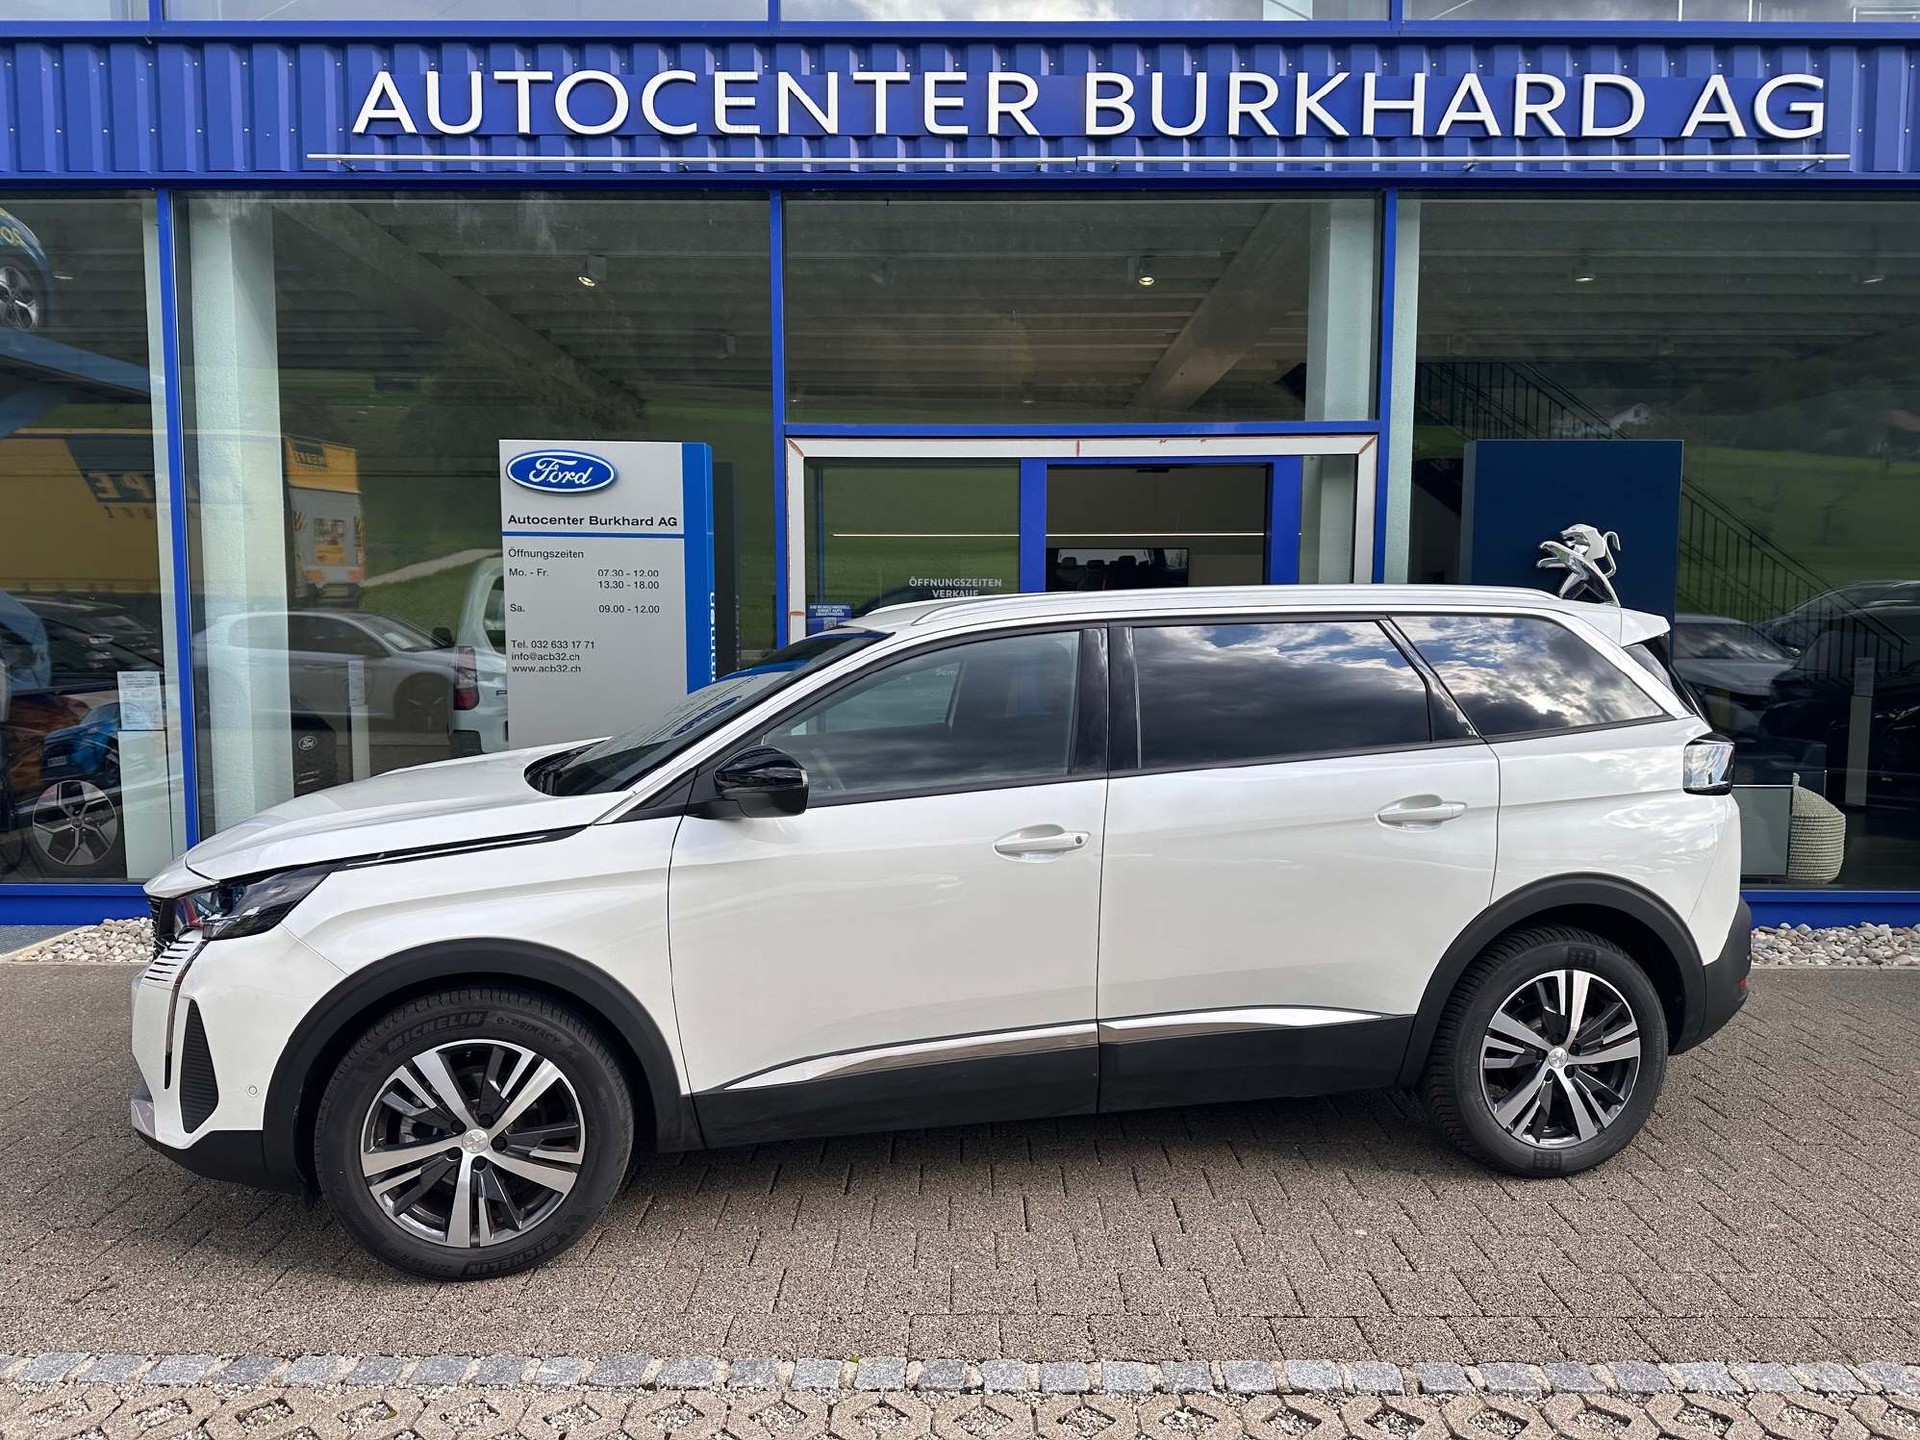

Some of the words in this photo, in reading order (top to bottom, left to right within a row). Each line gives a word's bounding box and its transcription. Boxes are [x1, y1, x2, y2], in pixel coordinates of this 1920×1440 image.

[352, 70, 1040, 136] AUTOCENTER
[1085, 72, 1646, 137] BURKHARD
[1681, 73, 1824, 139] AG
[529, 457, 593, 487] Ford
[508, 514, 585, 526] Autocenter
[589, 515, 654, 527] Burkhard
[658, 516, 678, 527] AG
[508, 546, 584, 560] Öffnungszeiten
[508, 567, 527, 577] Mo.
[536, 568, 549, 577] Fr.
[597, 568, 624, 578] 07.30
[633, 569, 659, 578] 12.00
[598, 580, 624, 589] 13.30
[633, 580, 660, 590] 18.00
[909, 576, 1002, 588] ÖFFNUNGSZEITEN
[510, 603, 526, 613] Sa.
[598, 604, 625, 614] 09.00
[634, 605, 660, 614] 12.00
[511, 639, 529, 649] Tel.
[531, 640, 549, 649] 032
[551, 640, 569, 649] 633
[571, 640, 582, 649] 17
[585, 640, 595, 649] 71
[511, 652, 580, 662] info@acb32.ch
[511, 664, 582, 674] www.acb32.ch
[387, 1010, 487, 1050] MICHELIN
